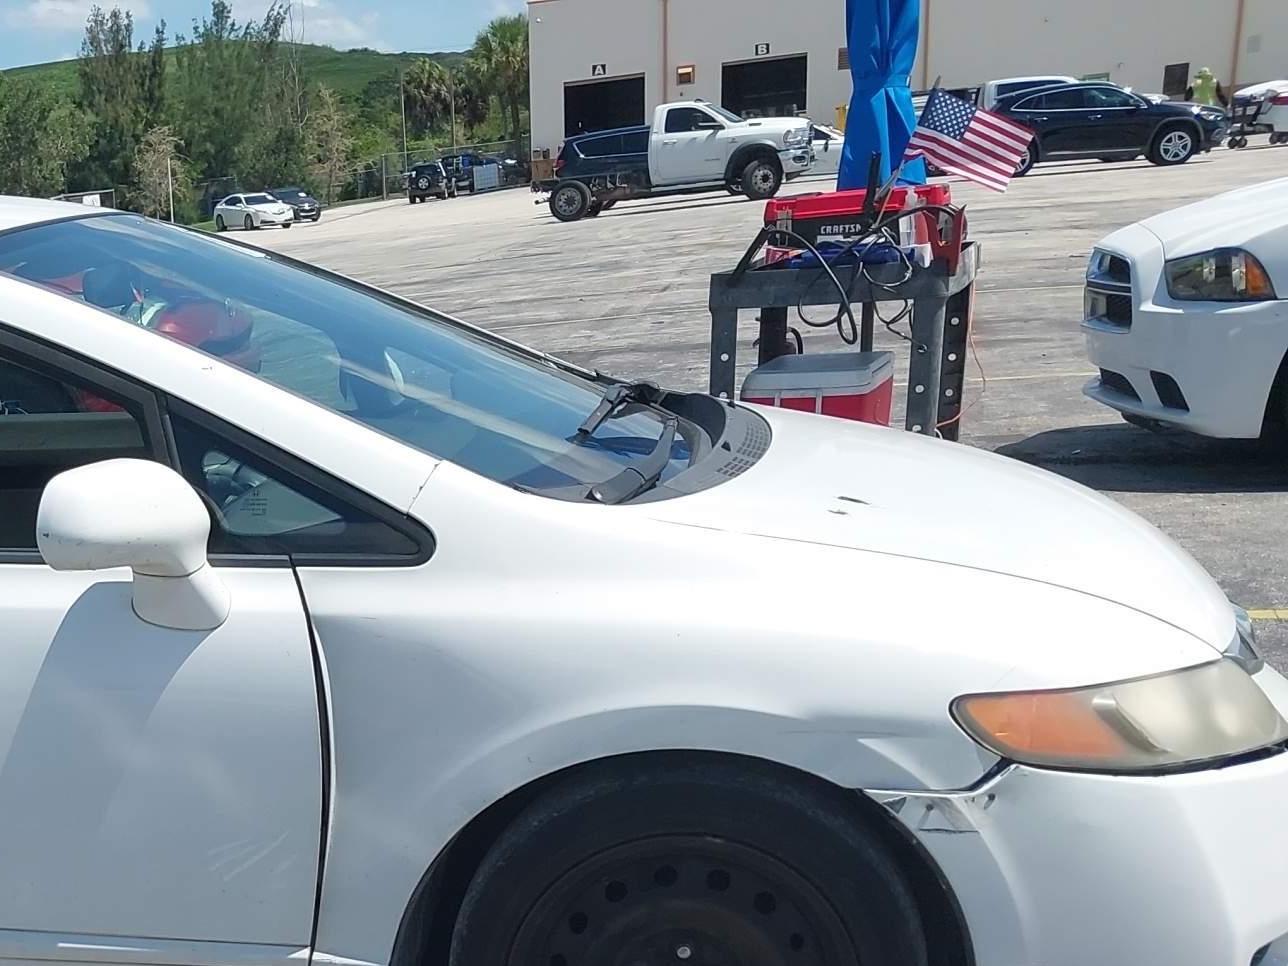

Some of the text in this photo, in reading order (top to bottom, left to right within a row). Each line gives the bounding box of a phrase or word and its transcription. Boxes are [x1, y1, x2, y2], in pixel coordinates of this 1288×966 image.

[757, 44, 768, 55] B
[593, 65, 604, 76] A
[820, 223, 862, 235] CRAFTSM
